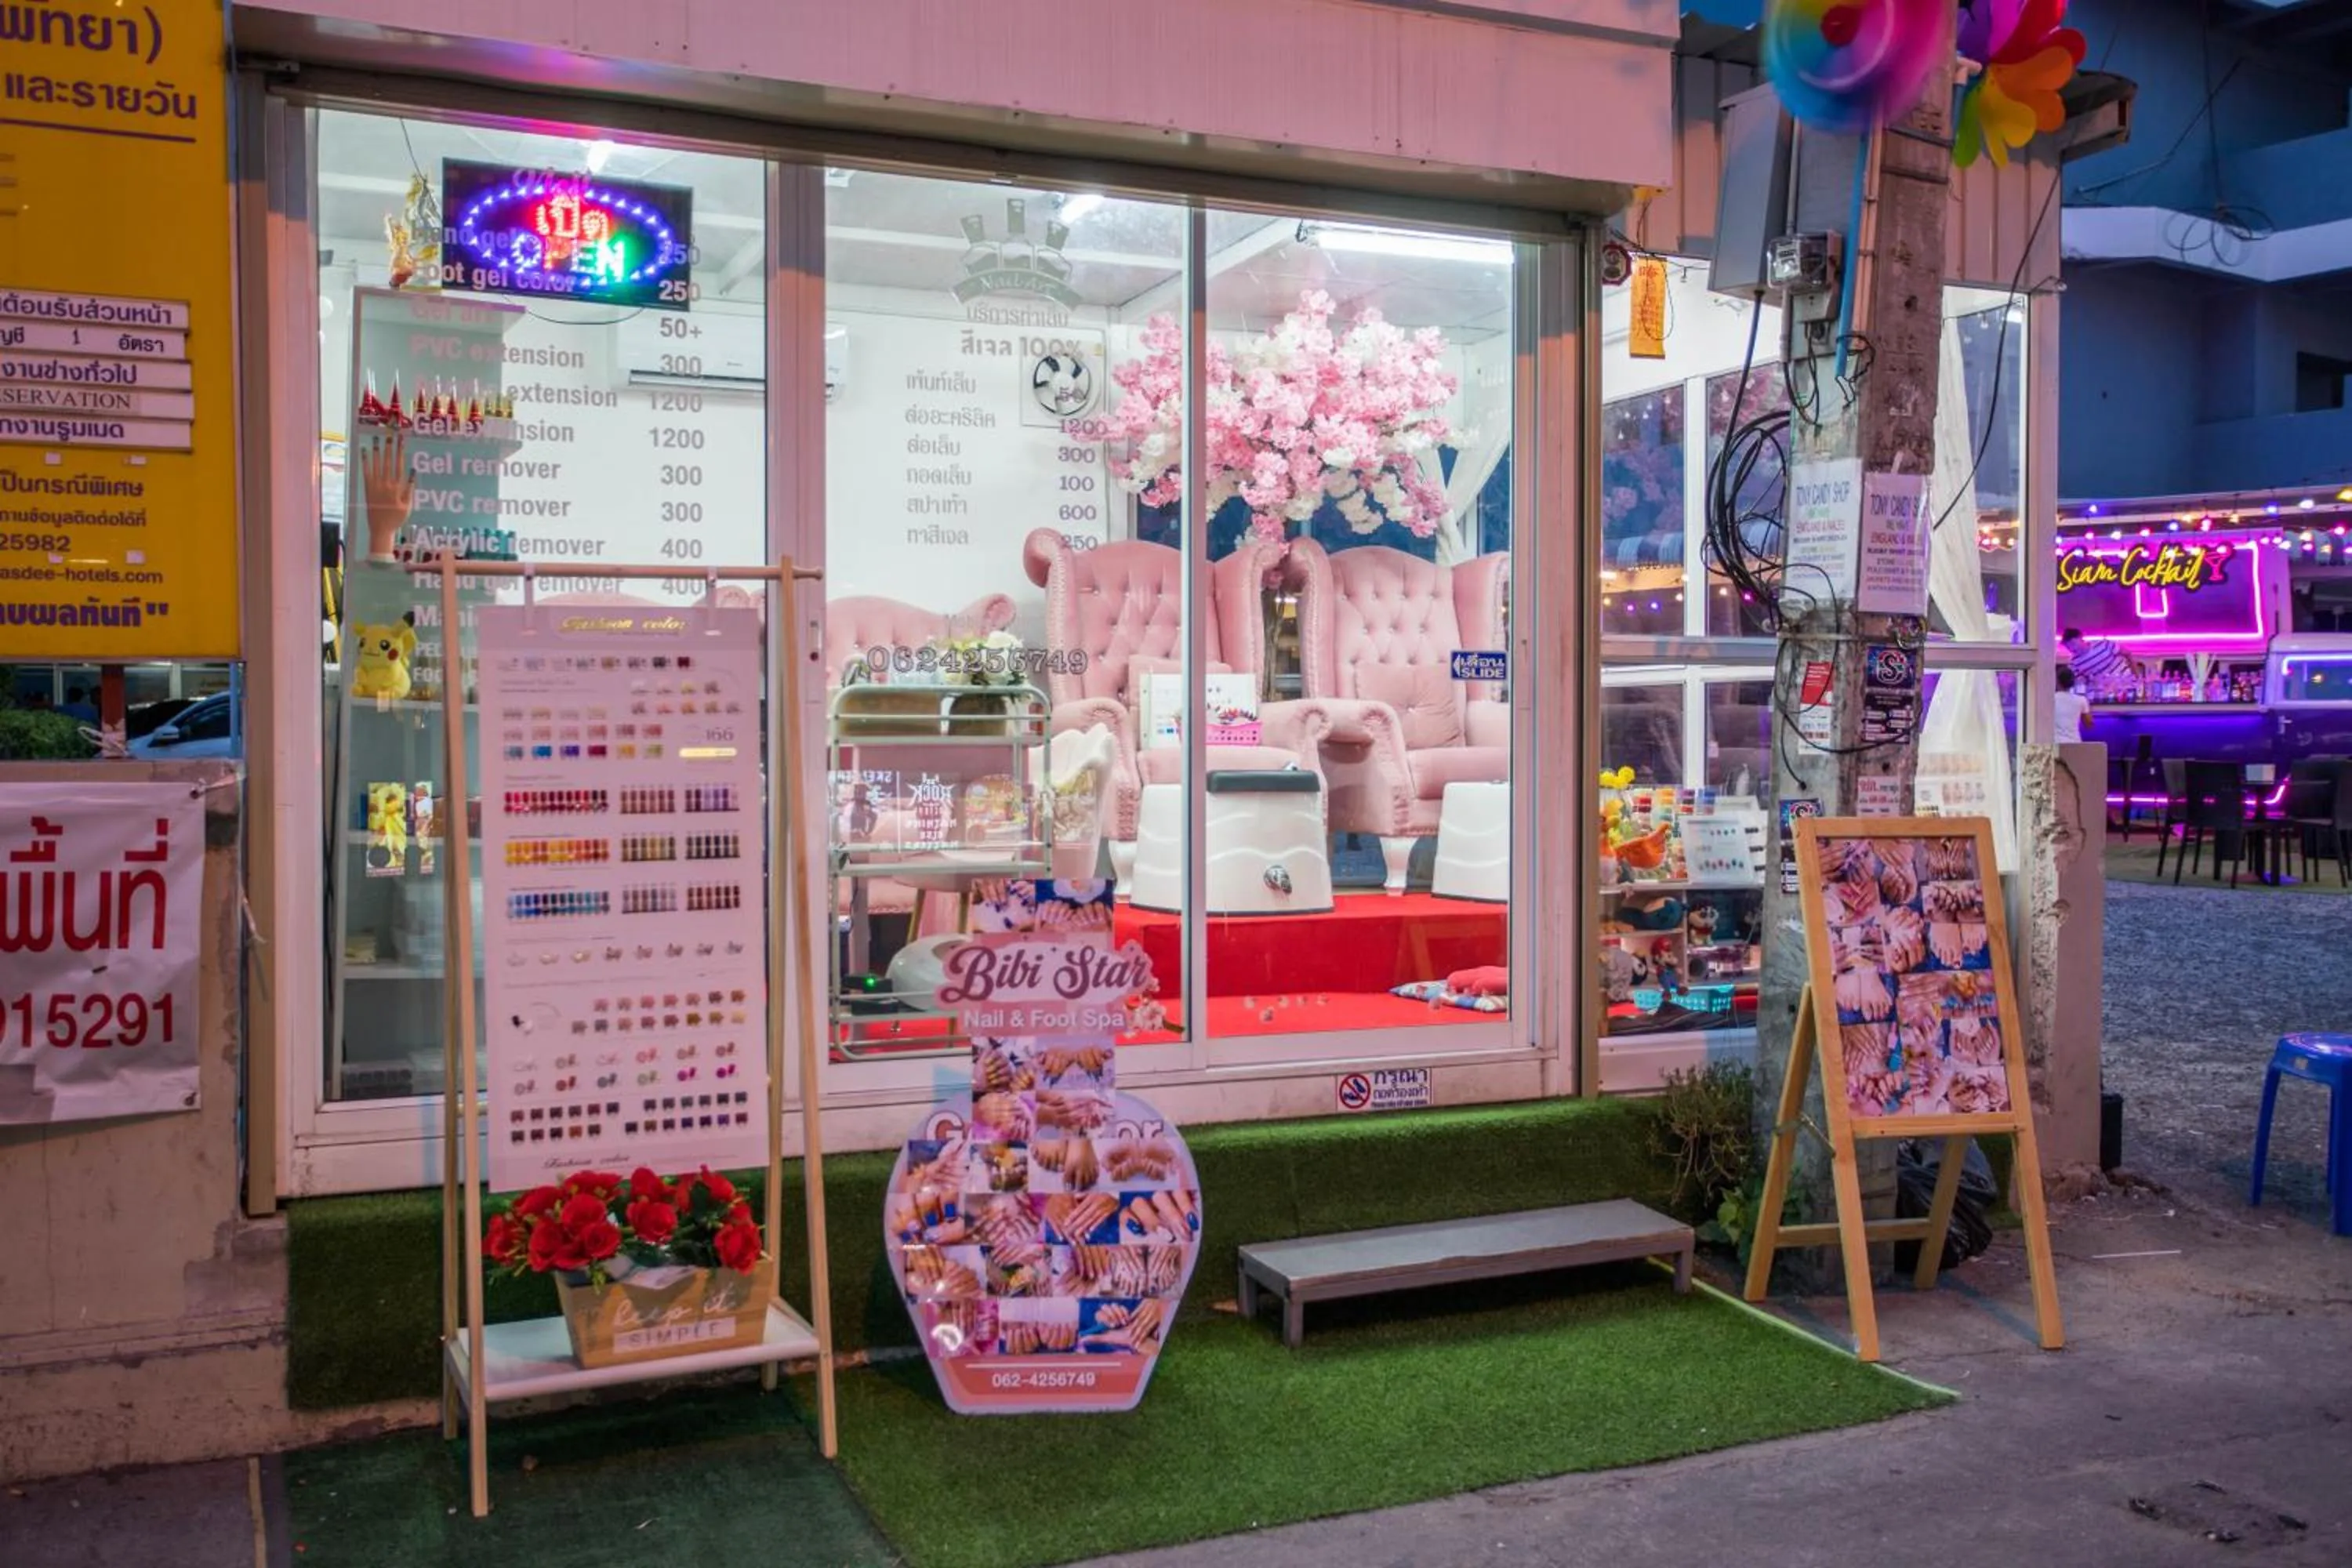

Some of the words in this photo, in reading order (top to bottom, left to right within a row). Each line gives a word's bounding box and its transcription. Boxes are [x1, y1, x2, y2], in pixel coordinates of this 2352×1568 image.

[5, 72, 197, 119] และรายวัน
[511, 230, 625, 281] OPEN
[472, 269, 509, 291] gel
[659, 280, 702, 302] 250
[0, 292, 172, 325] ต้อนรับส่วนหน้า
[659, 317, 702, 339] 50+
[118, 333, 165, 354] อัตรา
[960, 329, 1013, 357] สีเจล
[1018, 336, 1084, 359] 100%
[469, 342, 585, 368] extension
[660, 354, 702, 378] 300
[0, 387, 131, 409] SERVATION
[506, 383, 619, 408] extension
[649, 390, 704, 413] 1200
[463, 417, 575, 445] exnsion
[648, 427, 705, 451] 1200
[1059, 418, 1109, 436] 1200
[906, 433, 961, 456] ต่อเล็บ
[1058, 445, 1096, 464] 300
[412, 451, 454, 474] Gel
[461, 456, 562, 481] remover
[660, 464, 703, 487] 300
[1059, 475, 1095, 492] 100
[413, 489, 465, 513] PVC
[472, 495, 572, 518] remover
[660, 502, 703, 524] 300
[906, 493, 967, 515] สปาเท้า
[1058, 504, 1098, 521] 600
[414, 527, 499, 556] Acrylic
[507, 534, 607, 557] remover
[659, 539, 703, 561] 400
[906, 523, 969, 546] ทาสีเจล
[1060, 534, 1098, 551] 250
[0, 567, 164, 584] asdee-hotels.com
[2056, 551, 2118, 592] Siam
[2120, 544, 2207, 590] Cocktail
[414, 572, 475, 589] Had
[535, 575, 626, 595] emover
[661, 574, 703, 596] 400
[866, 645, 1088, 675] 0624256749
[1461, 666, 1504, 679] SLIDE
[939, 945, 1044, 1004] Bibi
[1053, 944, 1149, 1000] Star
[964, 1009, 1004, 1029] Nail
[1008, 1010, 1025, 1029] &
[1030, 1009, 1078, 1029] Foot
[1083, 1008, 1126, 1032] Spa
[1374, 1068, 1428, 1087] กรุณา
[628, 1321, 722, 1346] SIMPLE
[991, 1372, 1096, 1388] 062-4256749
